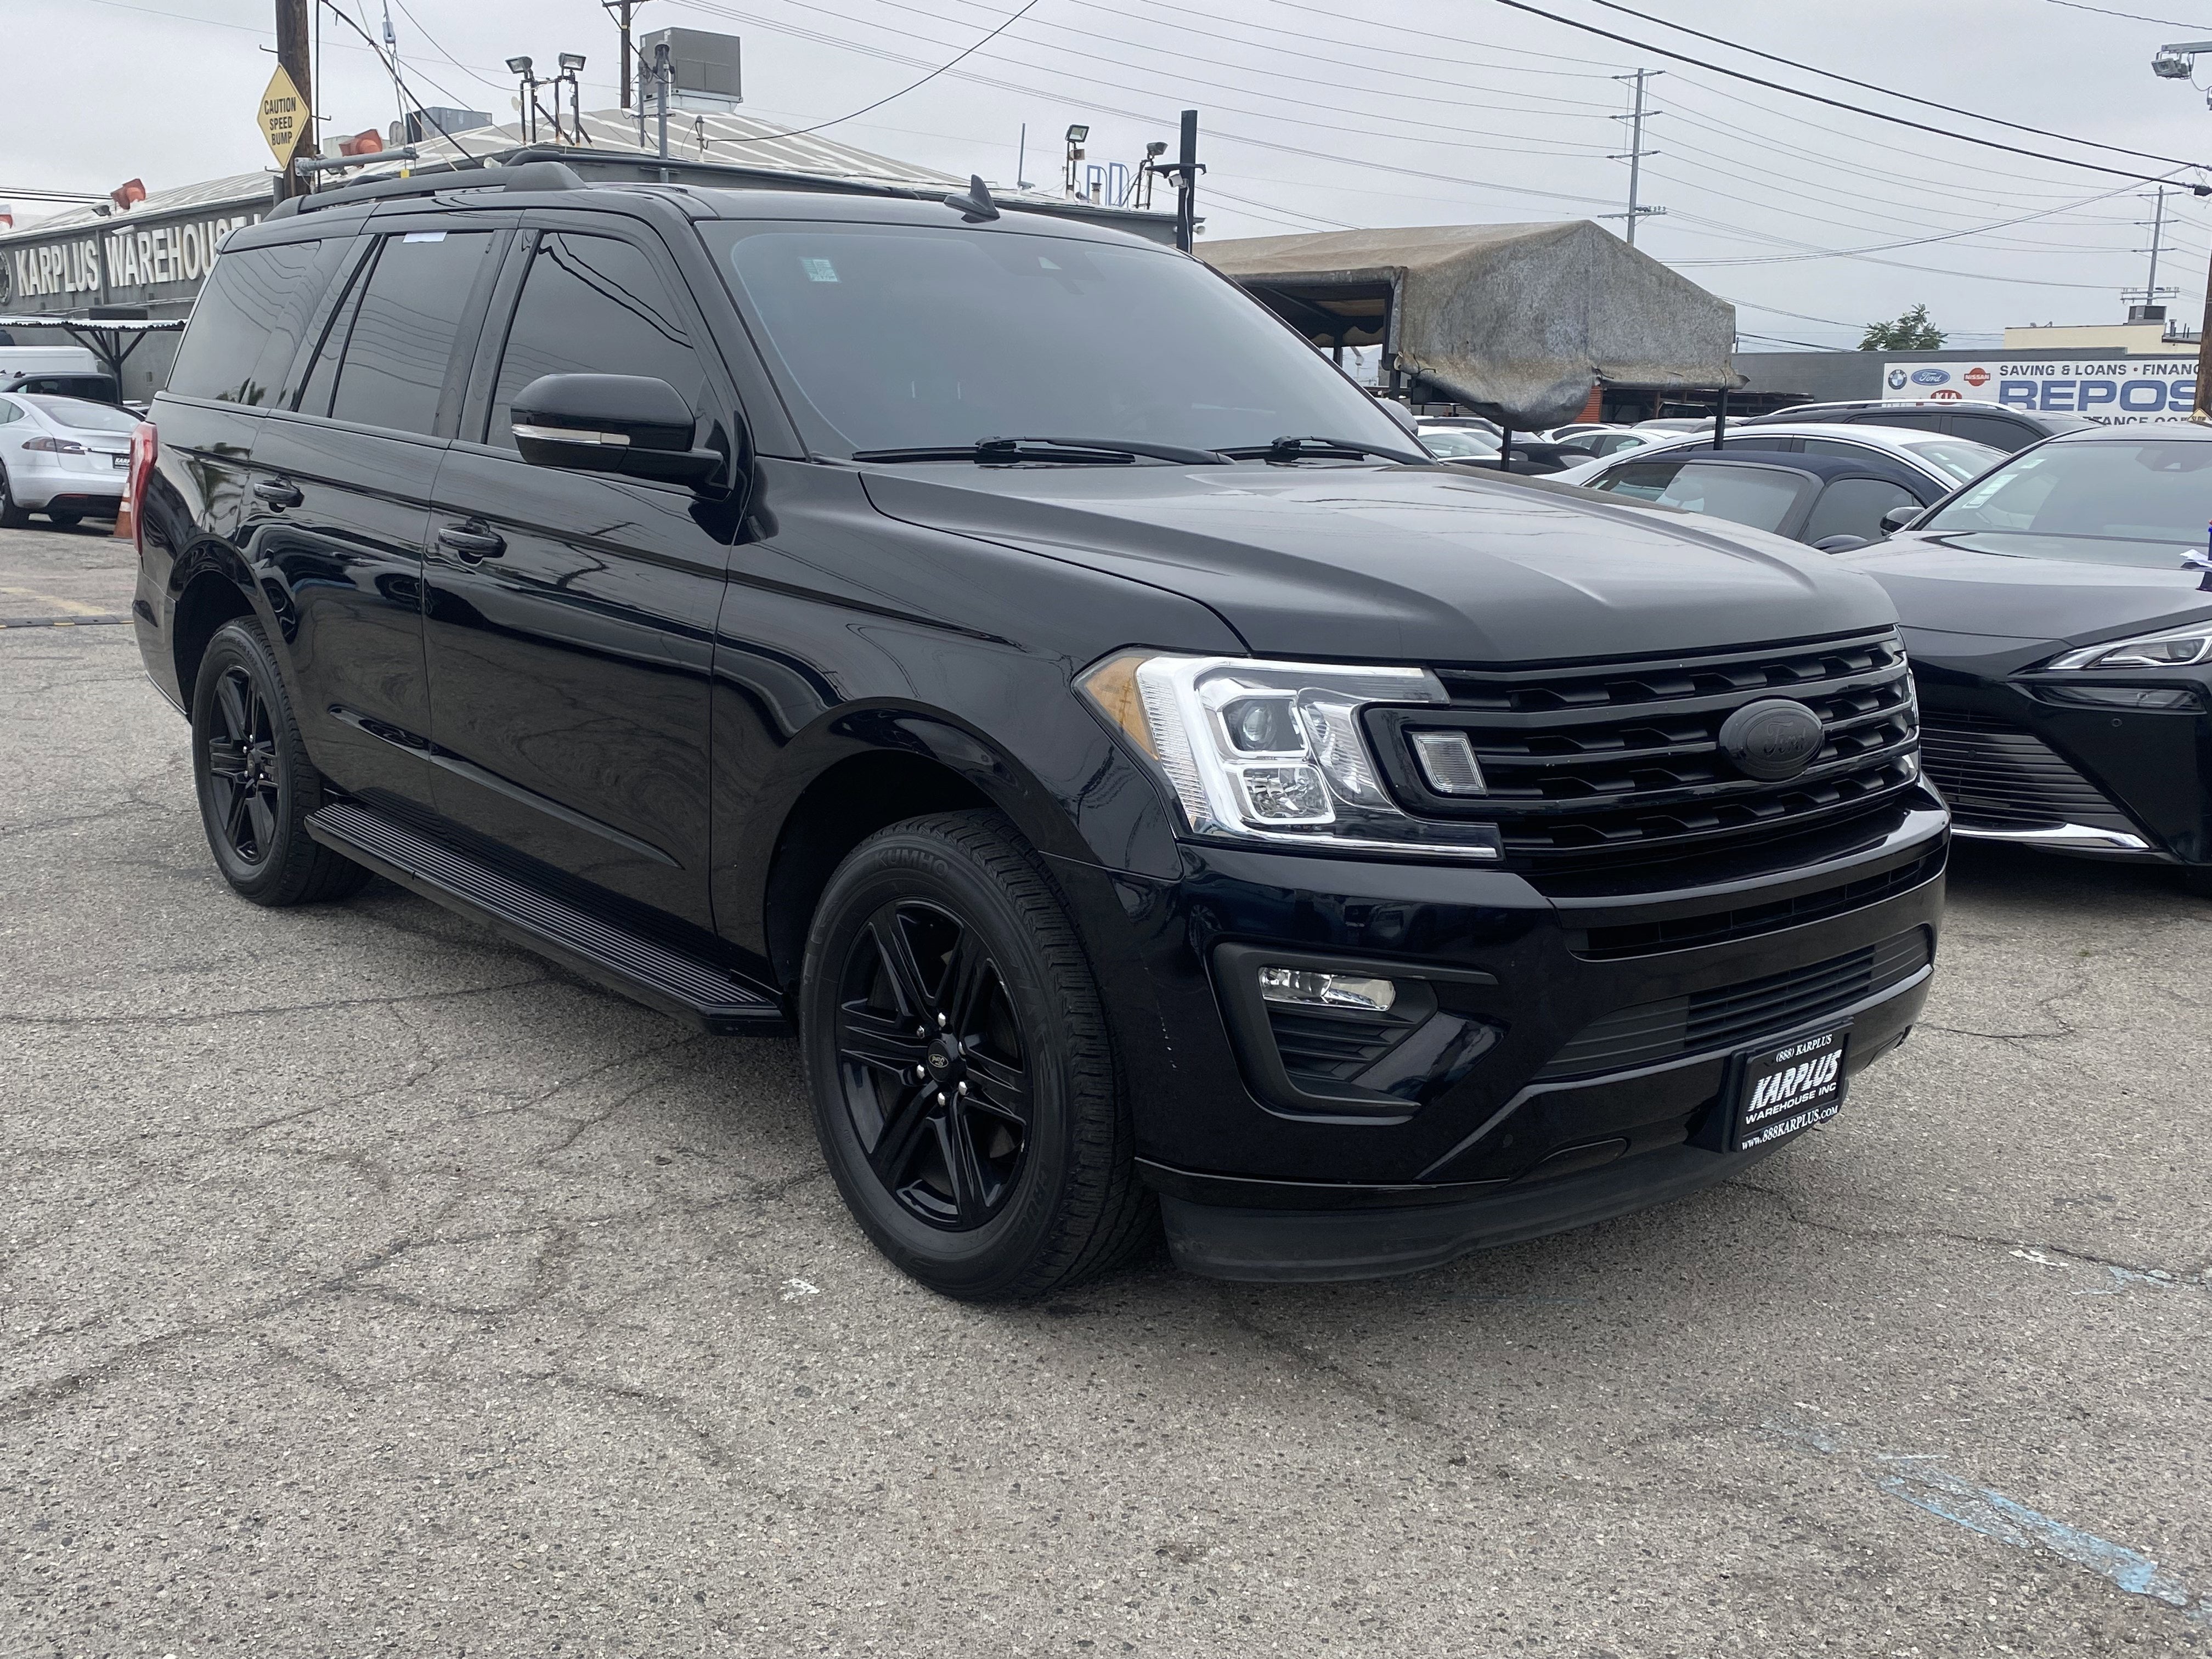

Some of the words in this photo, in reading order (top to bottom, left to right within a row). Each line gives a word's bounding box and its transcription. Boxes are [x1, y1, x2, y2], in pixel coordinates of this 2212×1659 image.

[264, 97, 296, 115] CAUTION
[269, 116, 292, 131] SPEED
[272, 132, 292, 146] BUMP
[15, 240, 101, 297] KARPLUS
[105, 216, 247, 287] WAREHOU
[1919, 371, 1943, 383] Ford
[2000, 365, 2055, 376] SAVING
[2061, 365, 2071, 375] &
[2075, 364, 2127, 375] LOANS
[1764, 720, 1807, 757] Ford
[876, 849, 949, 877] KUMHO
[1776, 1048, 1795, 1063] (888)
[1796, 1034, 1832, 1056] KARPLUS
[1747, 1049, 1842, 1112] KARPLUS
[1746, 1090, 1816, 1125] WAREHOUSE
[1818, 1082, 1837, 1096] INC
